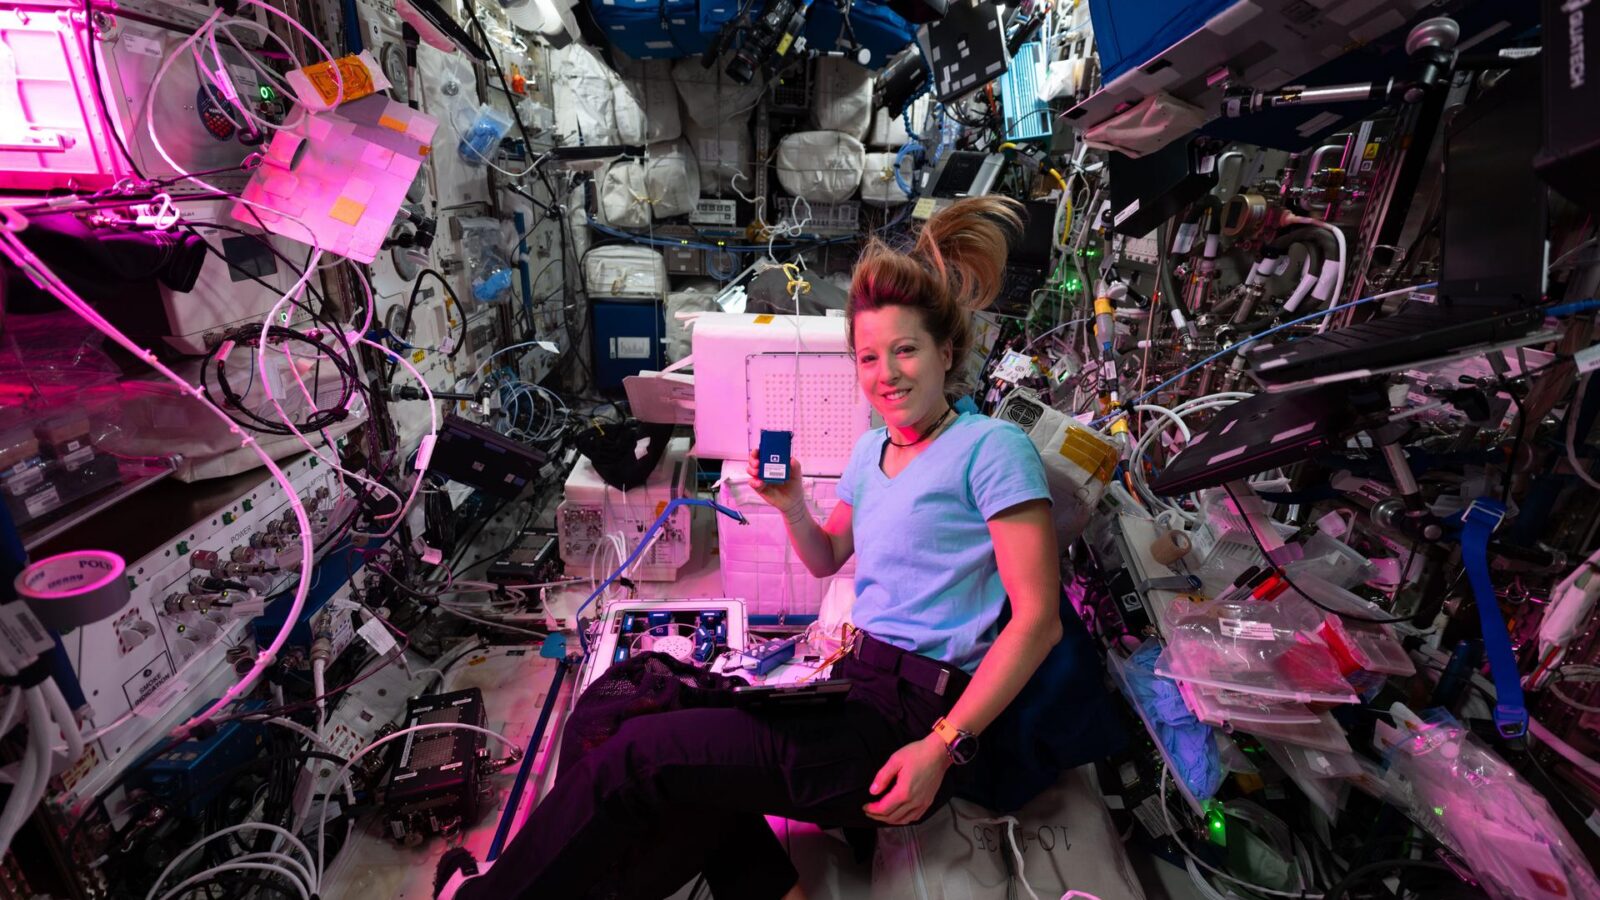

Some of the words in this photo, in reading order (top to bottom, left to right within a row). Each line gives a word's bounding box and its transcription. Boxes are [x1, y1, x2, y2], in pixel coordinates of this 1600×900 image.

[230, 525, 252, 544] POWER
[134, 673, 171, 706] INDICATION
[139, 671, 162, 694] SMOKE
